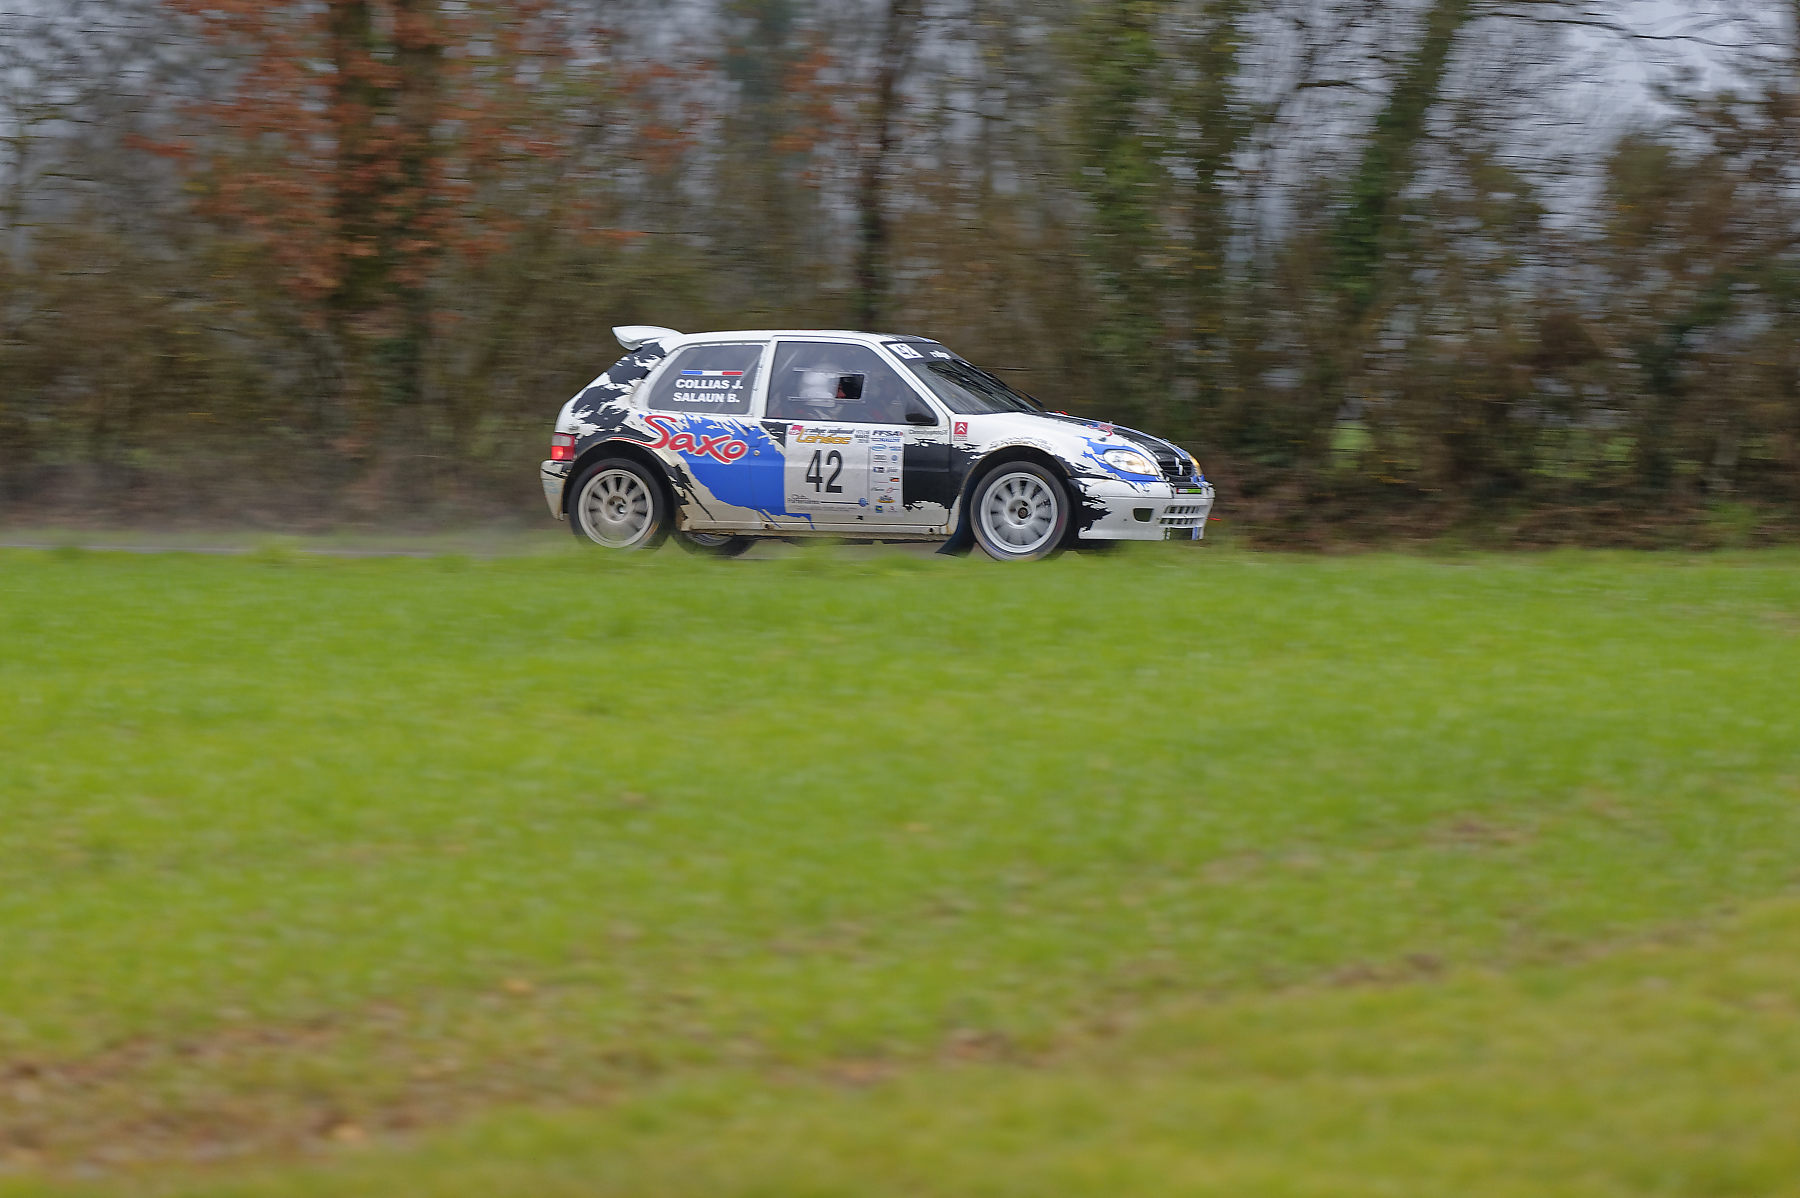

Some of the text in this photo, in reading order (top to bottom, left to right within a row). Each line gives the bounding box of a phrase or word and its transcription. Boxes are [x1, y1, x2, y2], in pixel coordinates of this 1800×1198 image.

[672, 392, 741, 403] SALAUN B.
[675, 379, 744, 389] COLLIAS J.
[607, 415, 749, 465] Saxo
[806, 450, 843, 494] 42
